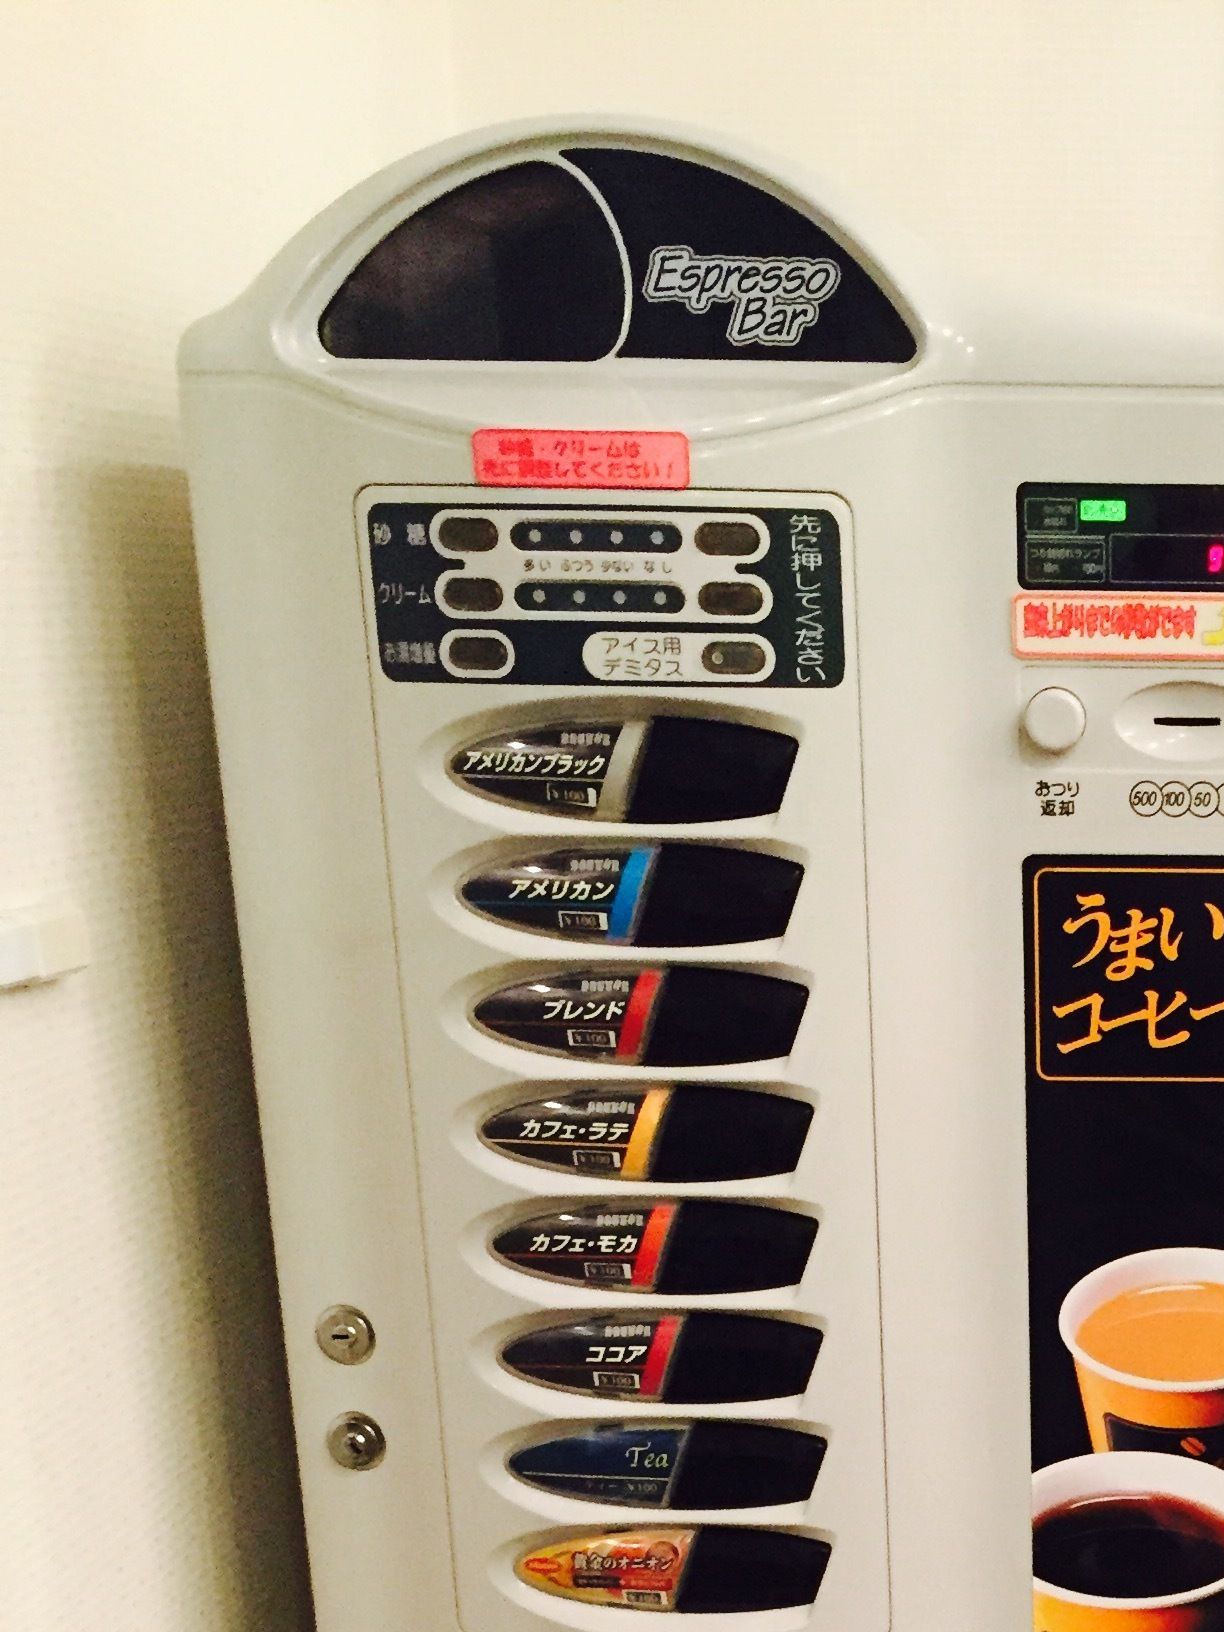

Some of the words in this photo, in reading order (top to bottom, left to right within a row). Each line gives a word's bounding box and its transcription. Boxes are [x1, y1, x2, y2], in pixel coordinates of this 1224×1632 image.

[648, 250, 836, 309] Espresso
[733, 296, 814, 341] Bar
[523, 558, 551, 574] 多い
[560, 559, 595, 573] ふつう
[600, 559, 634, 574] 少ない
[643, 560, 673, 574] なし
[378, 582, 433, 605] クリーム
[789, 514, 826, 683] 先に押してください
[601, 636, 682, 655] アイス用
[602, 658, 683, 676] デミタス
[463, 751, 606, 776] アメリカンブラック
[1034, 780, 1080, 797] おつり
[1132, 791, 1157, 806] 500
[1163, 791, 1185, 806] 100
[1193, 792, 1212, 807] 50
[1040, 800, 1075, 817] 返却
[508, 879, 615, 900] アメリカン
[542, 1000, 626, 1021] ブレンド
[519, 1119, 630, 1141] カフェ・ラテ
[529, 1234, 638, 1254] カフェ・モカ
[585, 1345, 648, 1364] ココア
[625, 1442, 669, 1469] Tea
